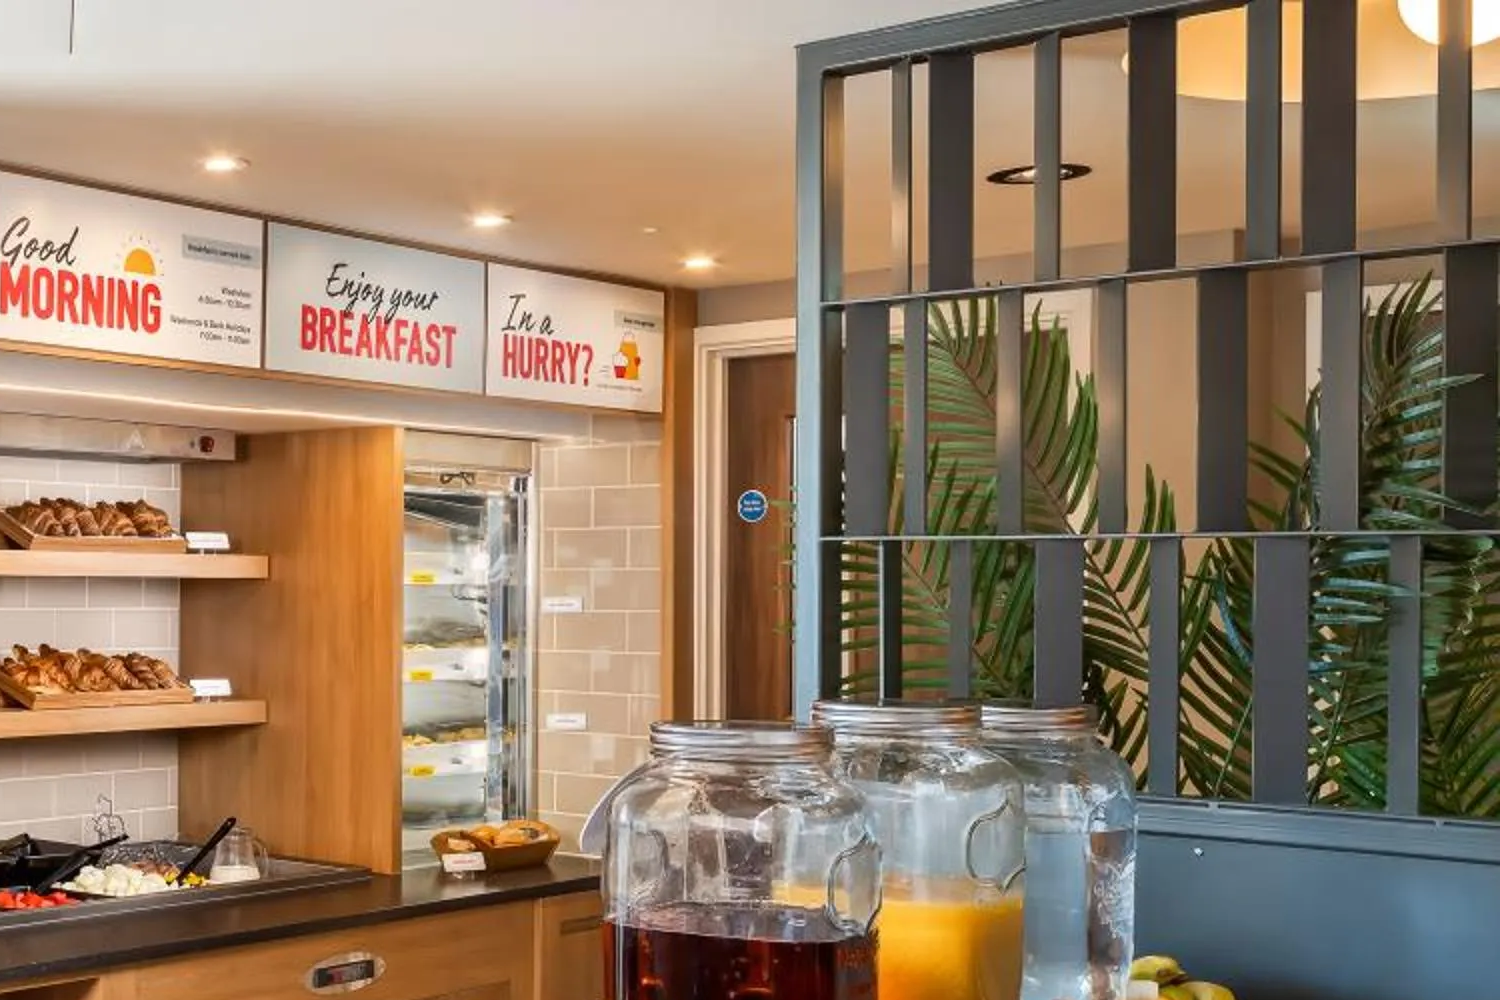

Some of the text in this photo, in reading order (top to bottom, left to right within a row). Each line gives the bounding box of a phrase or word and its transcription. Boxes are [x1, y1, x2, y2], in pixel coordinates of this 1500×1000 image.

[0, 216, 80, 268] Good
[0, 262, 162, 334] MORNING
[326, 262, 440, 325] Enjoy your
[501, 294, 556, 336] In a
[300, 303, 457, 369] BREAKFAST
[502, 333, 594, 386] HURRY?
